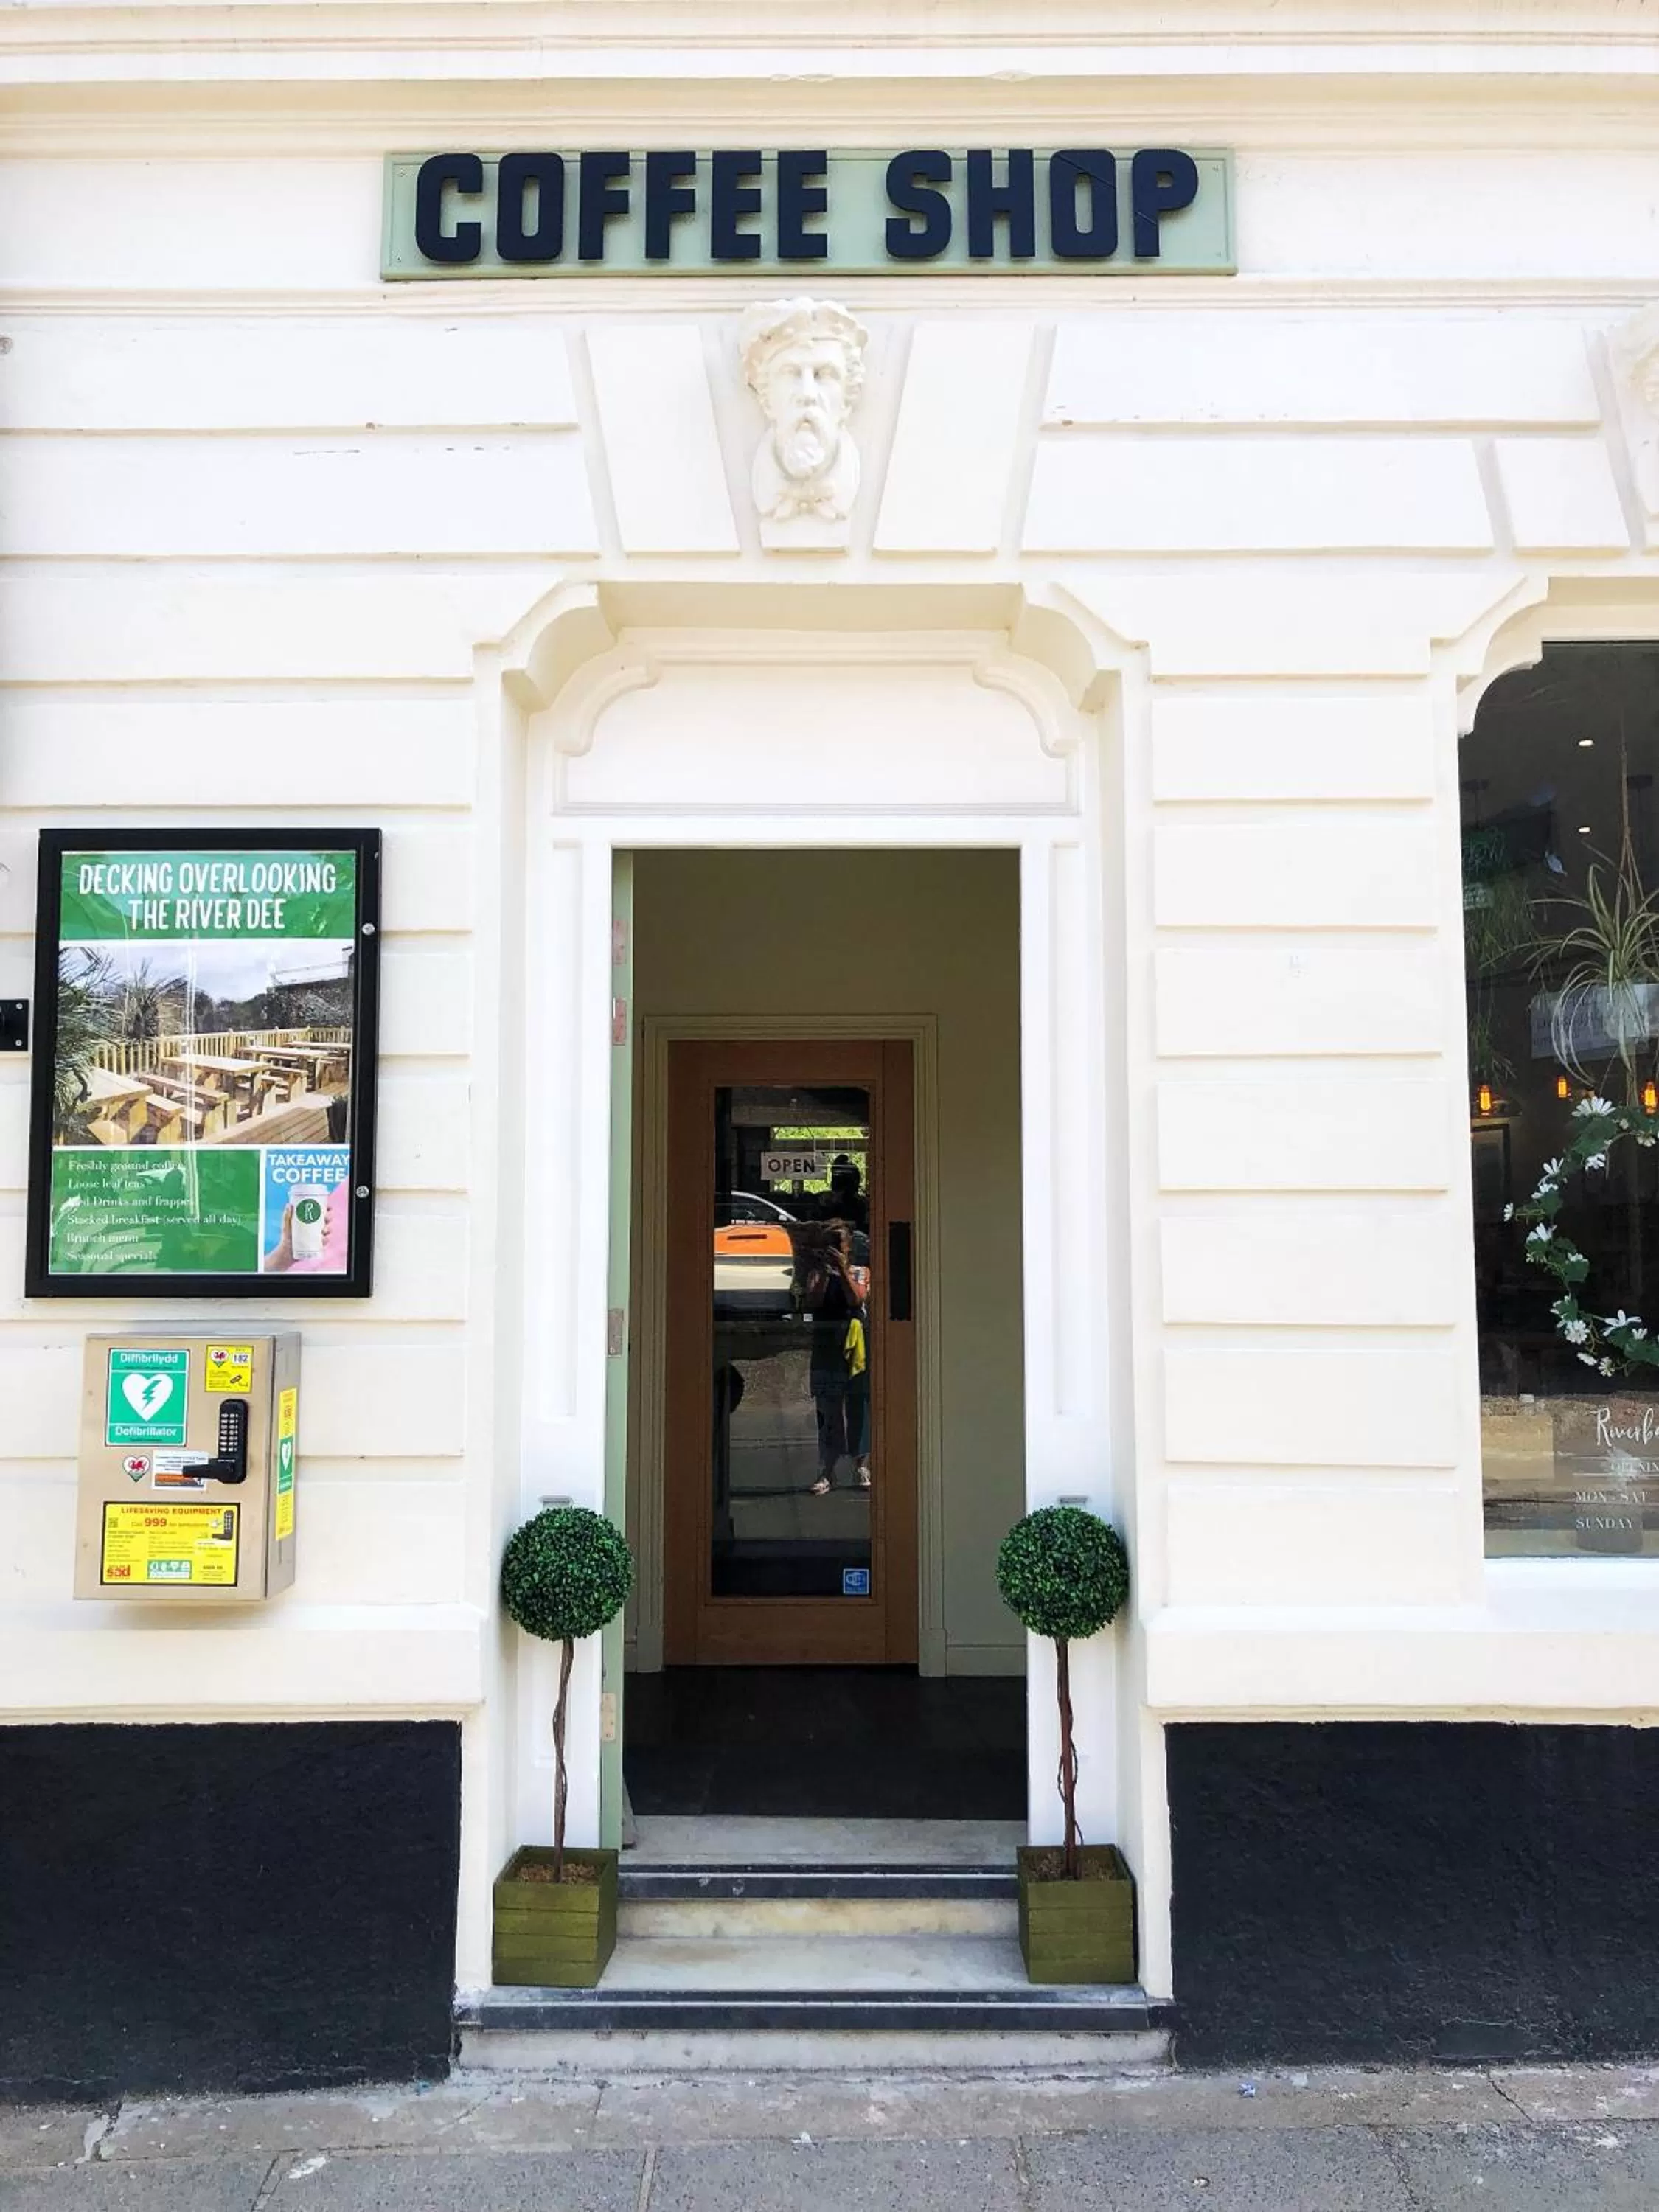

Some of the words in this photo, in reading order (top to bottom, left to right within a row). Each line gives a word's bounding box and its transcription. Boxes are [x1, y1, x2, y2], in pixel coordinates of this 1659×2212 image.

[415, 150, 827, 261] COFFEE
[886, 149, 1199, 258] SHOP
[79, 863, 173, 894] DECKING
[178, 863, 336, 894] OVERLOOKING
[128, 900, 169, 931] THE
[175, 899, 241, 930] RIVER
[247, 898, 286, 929] DEE
[68, 1160, 106, 1172] Freshly
[111, 1161, 149, 1172] ground
[268, 1154, 349, 1166] TAKEAWAY
[768, 1158, 815, 1173] OPEN
[272, 1168, 346, 1183] COFFEE
[68, 1178, 100, 1189] Loose
[102, 1178, 120, 1189] leaf
[94, 1196, 129, 1206] Drinks
[132, 1196, 152, 1206] and
[305, 1203, 313, 1220] R
[67, 1214, 109, 1225] Stacked
[111, 1214, 160, 1225] breakfast
[203, 1214, 216, 1225] all
[67, 1233, 105, 1243] Brunch
[115, 1426, 177, 1437] Defibrillator
[1575, 1491, 1607, 1503] MON
[1619, 1491, 1648, 1503] SAT
[121, 1506, 170, 1514] LIFESAVING
[172, 1507, 222, 1515] EQUIPMENT
[144, 1517, 167, 1527] 999
[1576, 1517, 1632, 1529] SUNDAY
